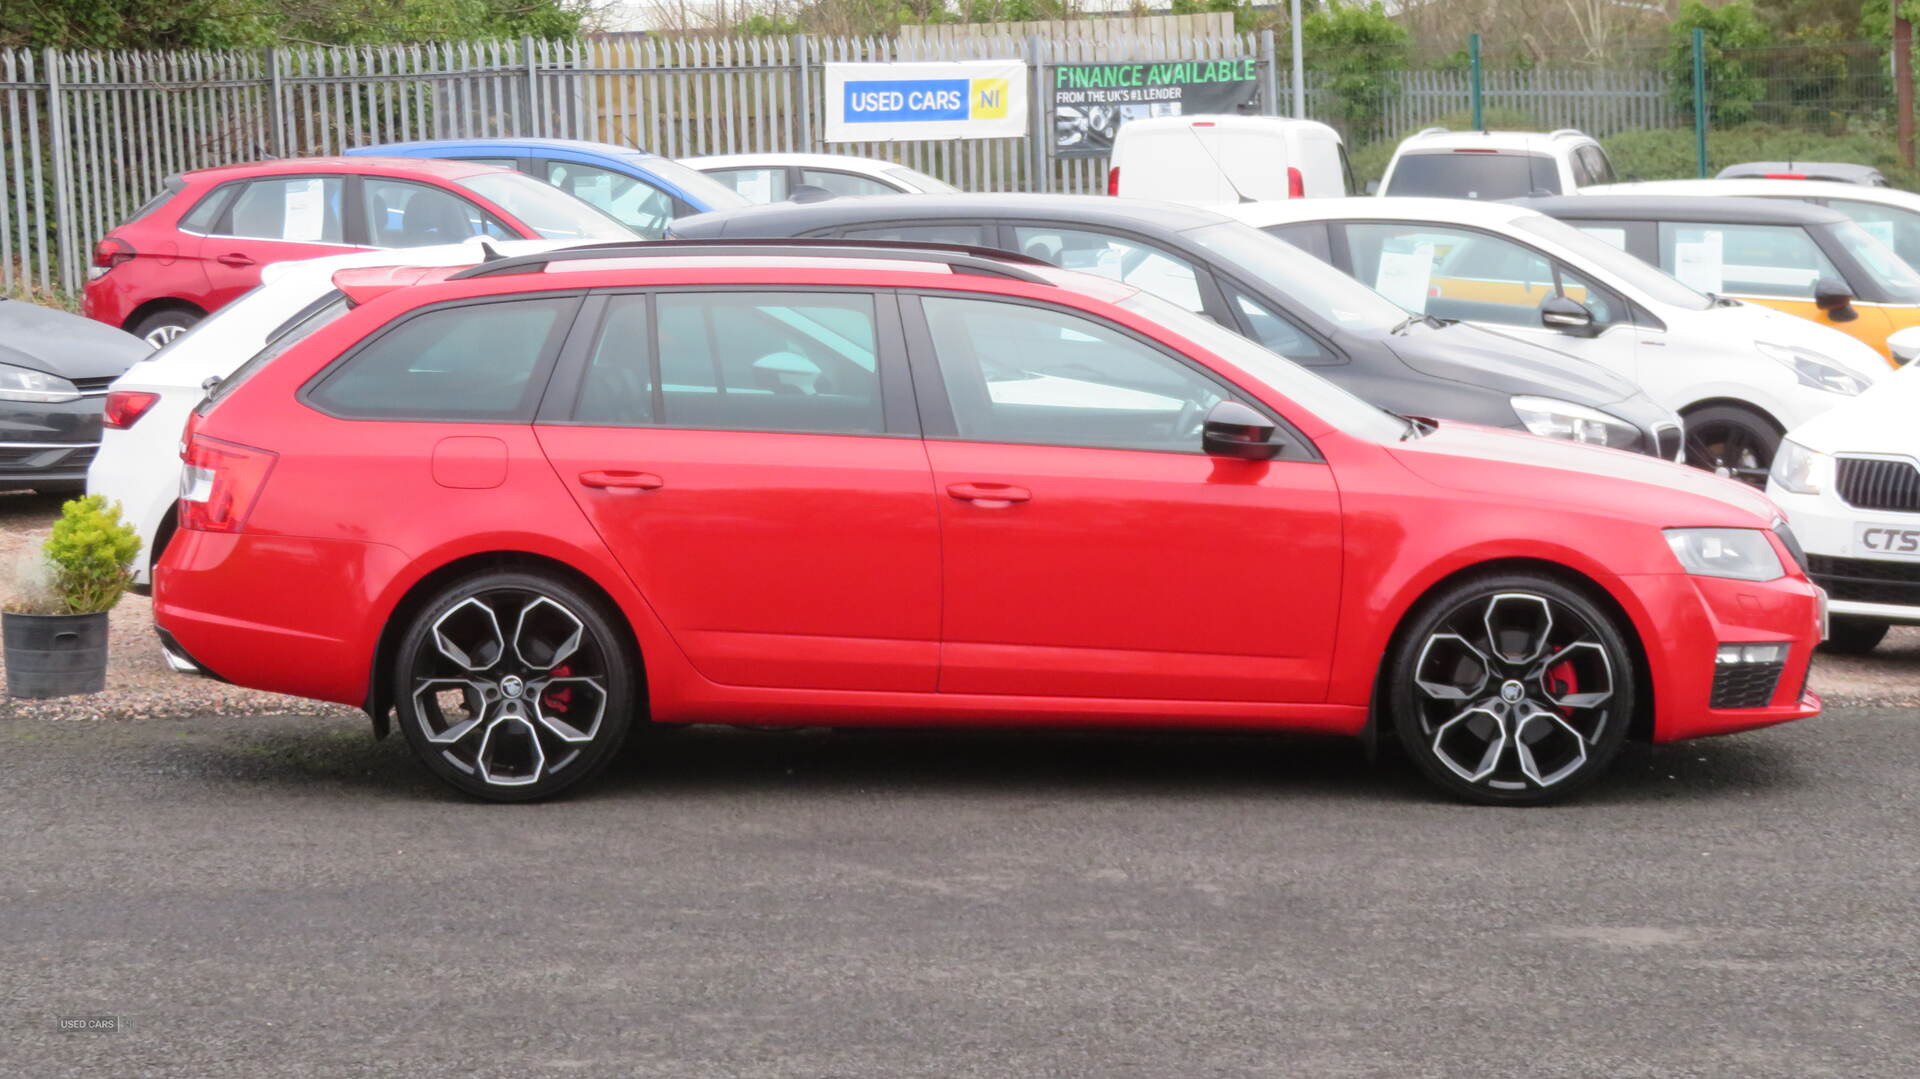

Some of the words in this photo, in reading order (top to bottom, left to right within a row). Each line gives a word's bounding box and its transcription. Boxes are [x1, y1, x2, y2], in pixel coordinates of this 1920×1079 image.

[1057, 65, 1143, 88] FINANCE
[1147, 60, 1256, 85] AVAILABLE
[852, 92, 903, 111] USED
[908, 91, 961, 110] CARS
[980, 90, 999, 108] NI
[1056, 91, 1085, 103] FROM
[1087, 90, 1105, 102] THE
[1107, 89, 1129, 102] UK'S
[1144, 87, 1182, 100] LENDER
